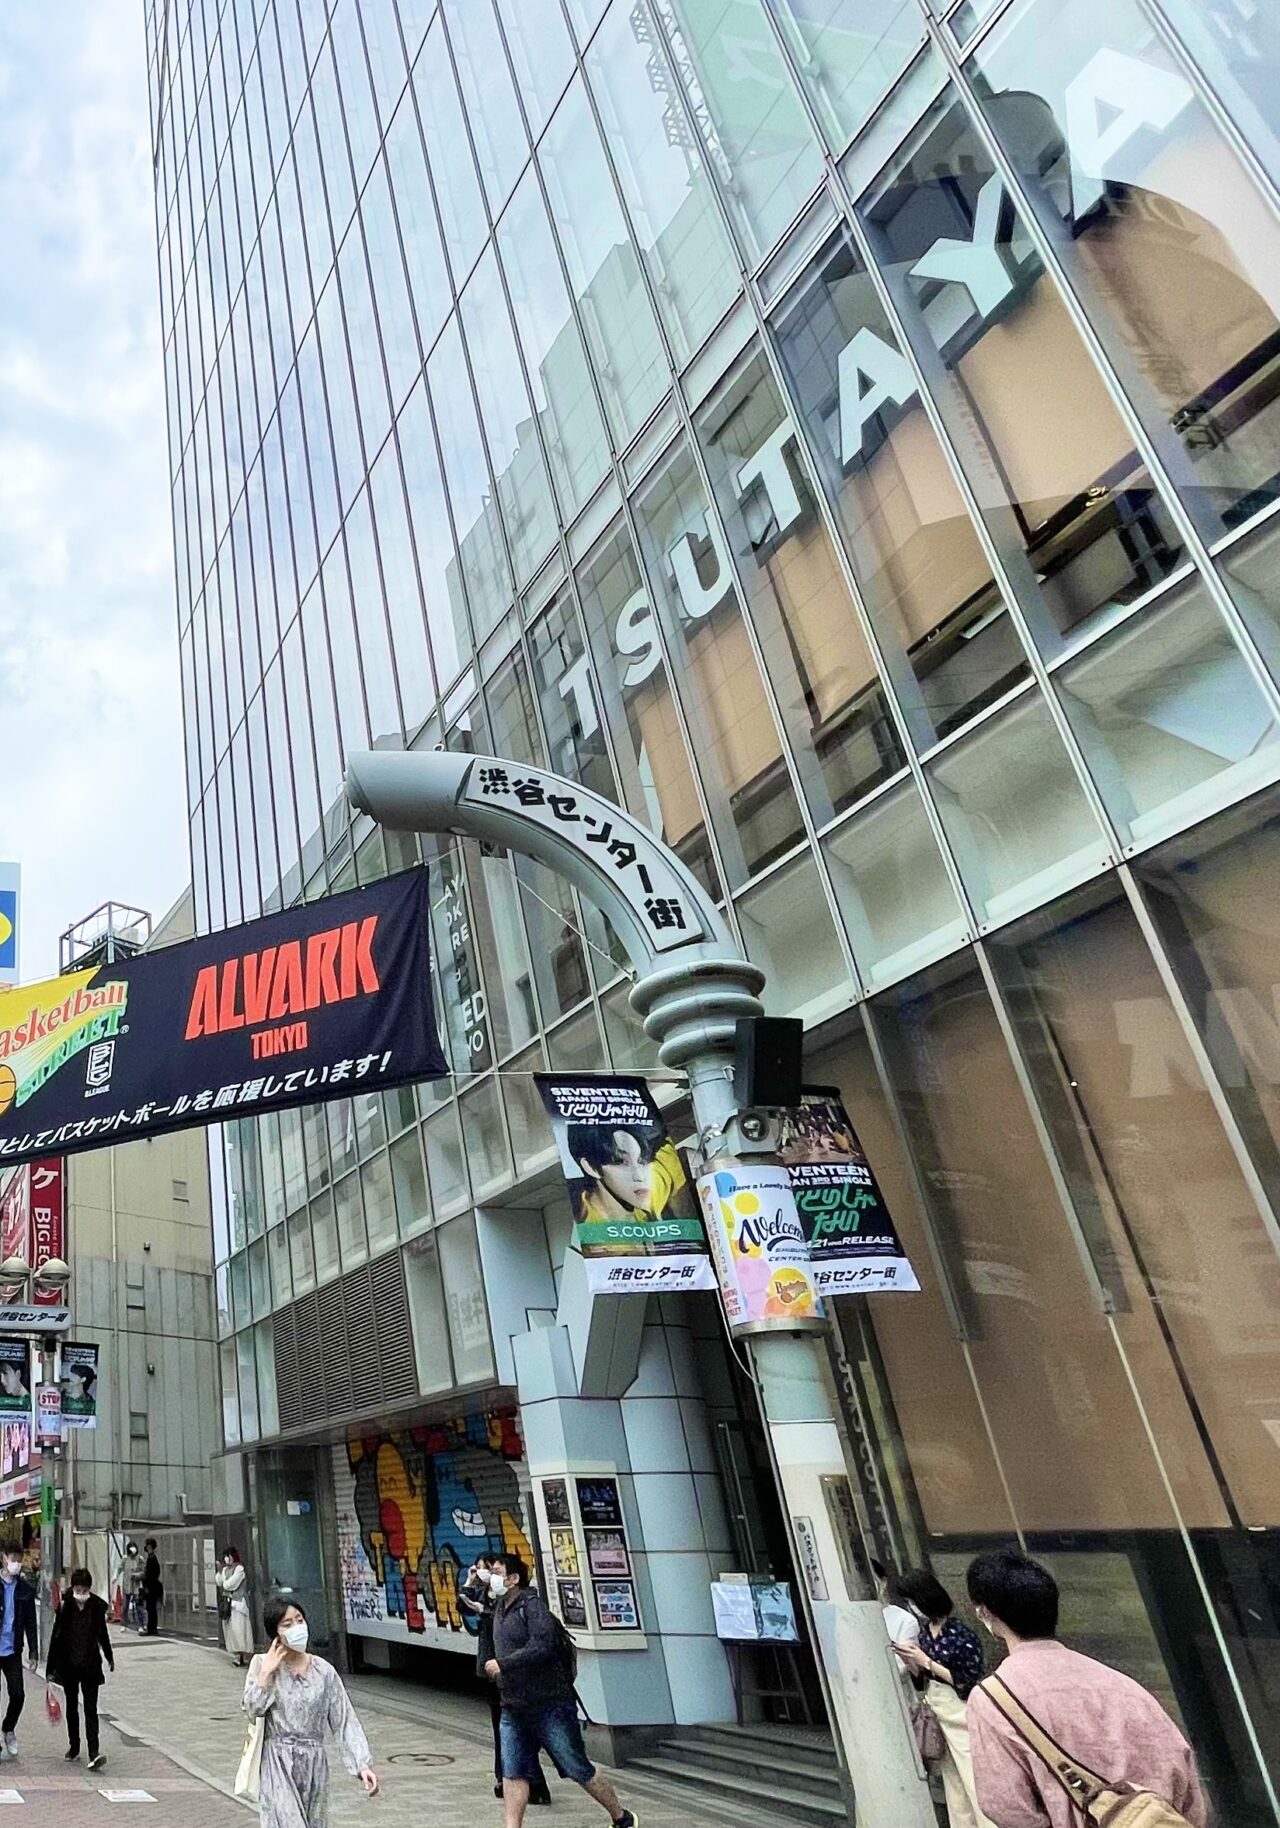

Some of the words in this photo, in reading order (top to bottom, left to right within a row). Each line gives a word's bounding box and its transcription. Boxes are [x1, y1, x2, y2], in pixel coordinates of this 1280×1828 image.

[558, 46, 1195, 742] TSUTAYA
[479, 768, 687, 930] 渋谷センター街
[184, 915, 380, 1041] ALVARK
[251, 1021, 308, 1060] TOKYO
[550, 1087, 641, 1098] SEVENTEEN
[607, 1096, 644, 1104] SINGLE
[610, 1117, 653, 1126] RELEASE
[788, 1165, 870, 1177] VENTEEN
[831, 1176, 872, 1186] SINGLE
[607, 1223, 682, 1239] S.COUPS
[842, 1236, 895, 1245] RELEASE
[608, 1265, 696, 1280] 渋谷センター街
